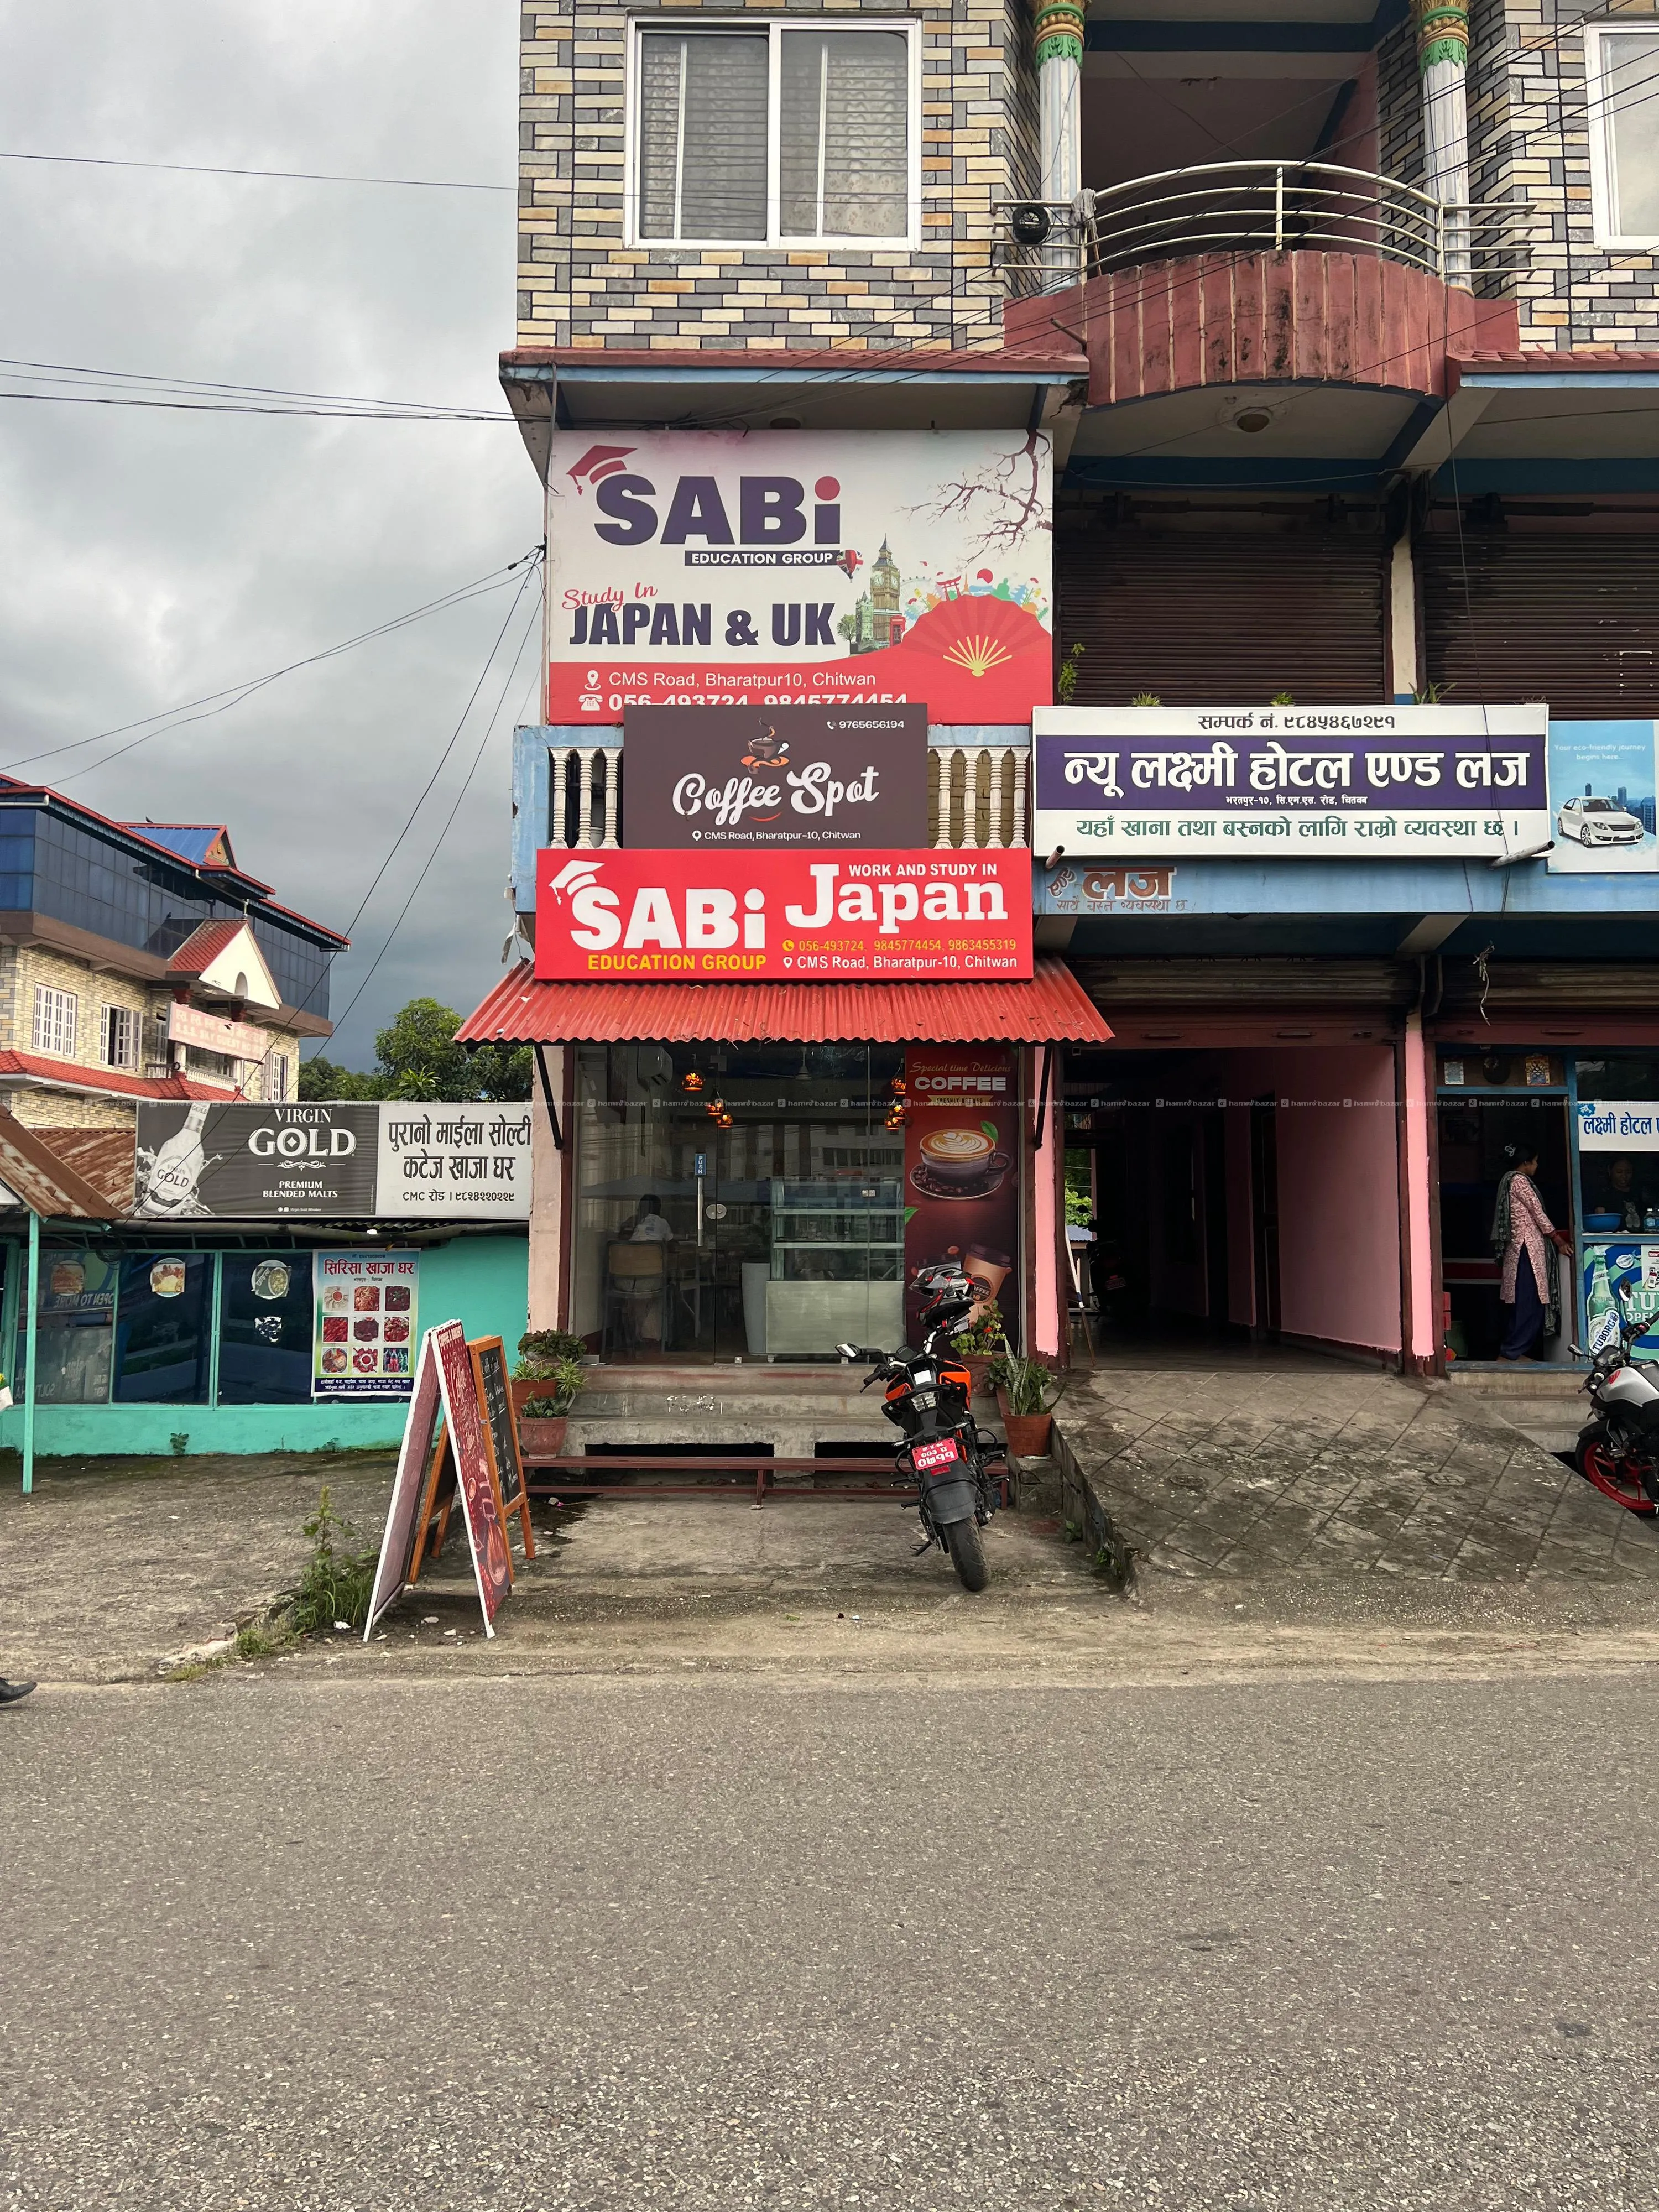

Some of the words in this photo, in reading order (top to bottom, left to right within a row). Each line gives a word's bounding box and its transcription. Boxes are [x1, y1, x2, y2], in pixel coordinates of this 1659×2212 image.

[594, 474, 841, 546] SABi
[692, 553, 776, 564] EDUCATION
[782, 552, 833, 564] GROUP
[561, 587, 626, 612] Study
[635, 582, 658, 599] In
[570, 603, 711, 646] JAPAN
[725, 610, 758, 646] &
[772, 603, 835, 646] UK
[609, 672, 648, 686] CMS
[654, 672, 699, 688] Road,
[706, 672, 806, 690] Bharatpur10,
[812, 672, 876, 686] Chitwan
[839, 721, 905, 729] 9765656194
[1198, 712, 1254, 729] सम्पर्क
[1260, 713, 1278, 729] नं.
[1573, 744, 1616, 752] eco-friendly
[1064, 752, 1124, 799] न्यू
[1131, 742, 1238, 792] लक्ष्मी
[1250, 741, 1354, 791] होटल
[1365, 752, 1444, 787] एण्ड
[1455, 752, 1530, 789] लज
[672, 773, 782, 826] Coffee
[786, 761, 880, 817] Spot
[1341, 794, 1368, 804] चितवन
[1077, 815, 1115, 836] यहाँ
[1121, 820, 1171, 836] खाना
[1178, 820, 1217, 836] तथा
[1223, 816, 1292, 837] बस्नको
[1298, 816, 1348, 836] लागि
[1354, 816, 1397, 838] राम्रो
[1404, 821, 1477, 836] व्यवस्था
[704, 831, 726, 839] CMS
[728, 831, 754, 841] Road,
[756, 831, 820, 842] Bharatpur-10,
[822, 831, 861, 839] Chitwan
[849, 864, 893, 877] WORK
[897, 864, 926, 877] AND
[931, 863, 976, 876] STUDY
[981, 863, 998, 875] IN
[1082, 866, 1177, 900] लज
[785, 864, 1008, 934] Japan
[570, 886, 765, 950] SABi
[799, 940, 867, 952] 056-493724,
[874, 939, 945, 951] 9845774454,
[948, 938, 1016, 950] 9863455319
[588, 954, 700, 971] EDUCATION
[703, 954, 766, 971] GROUP
[797, 956, 828, 968] CMS
[832, 956, 869, 970] Road,
[873, 956, 960, 971] Bharatpur-10,
[965, 955, 1017, 968] Chitwan
[909, 1062, 948, 1074] Special
[971, 1062, 1012, 1072] Delicious
[915, 1077, 1006, 1091] COFFEE
[274, 1109, 332, 1123] VIRGIN
[1583, 1112, 1616, 1135] लक्ष्मी
[1620, 1112, 1652, 1135] होटल
[388, 1114, 432, 1152] पुरानो
[436, 1115, 484, 1149] माईला
[488, 1114, 532, 1146] सोल्टी
[248, 1128, 357, 1157] GOLD
[403, 1148, 444, 1179] कटेज
[448, 1156, 489, 1181] खाजा
[493, 1156, 516, 1181] घर
[157, 1168, 189, 1187] GOLD
[279, 1181, 322, 1189] PREMIUM
[403, 1192, 425, 1201] CMC
[428, 1189, 445, 1201] रोड
[324, 1259, 362, 1275] सिरिसा
[366, 1262, 395, 1274] खाजा
[398, 1262, 415, 1274] घर
[1592, 1319, 1616, 1353] TUBORG
